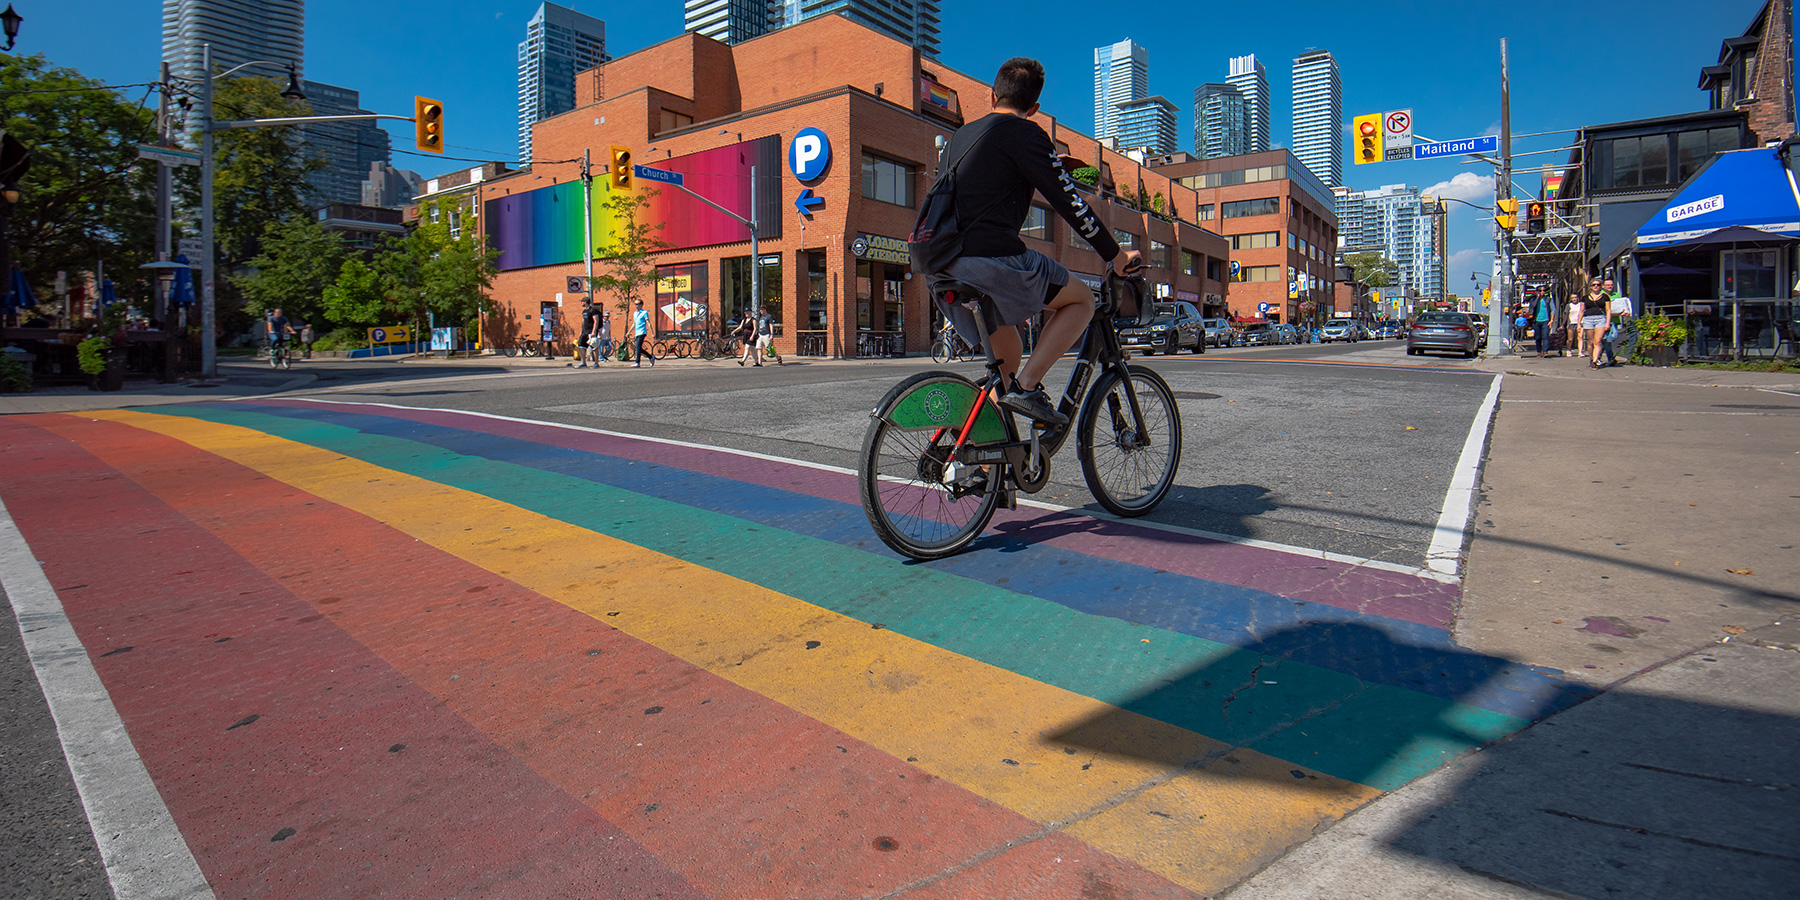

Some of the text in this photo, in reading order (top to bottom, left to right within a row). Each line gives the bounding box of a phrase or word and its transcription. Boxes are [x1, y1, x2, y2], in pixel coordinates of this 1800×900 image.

[795, 134, 821, 174] P
[1421, 139, 1474, 155] Maitland
[641, 167, 669, 180] Church
[1671, 199, 1719, 218] GARAGE
[866, 234, 909, 252] LOADED
[866, 247, 910, 264] PIEROGI
[375, 330, 382, 340] P
